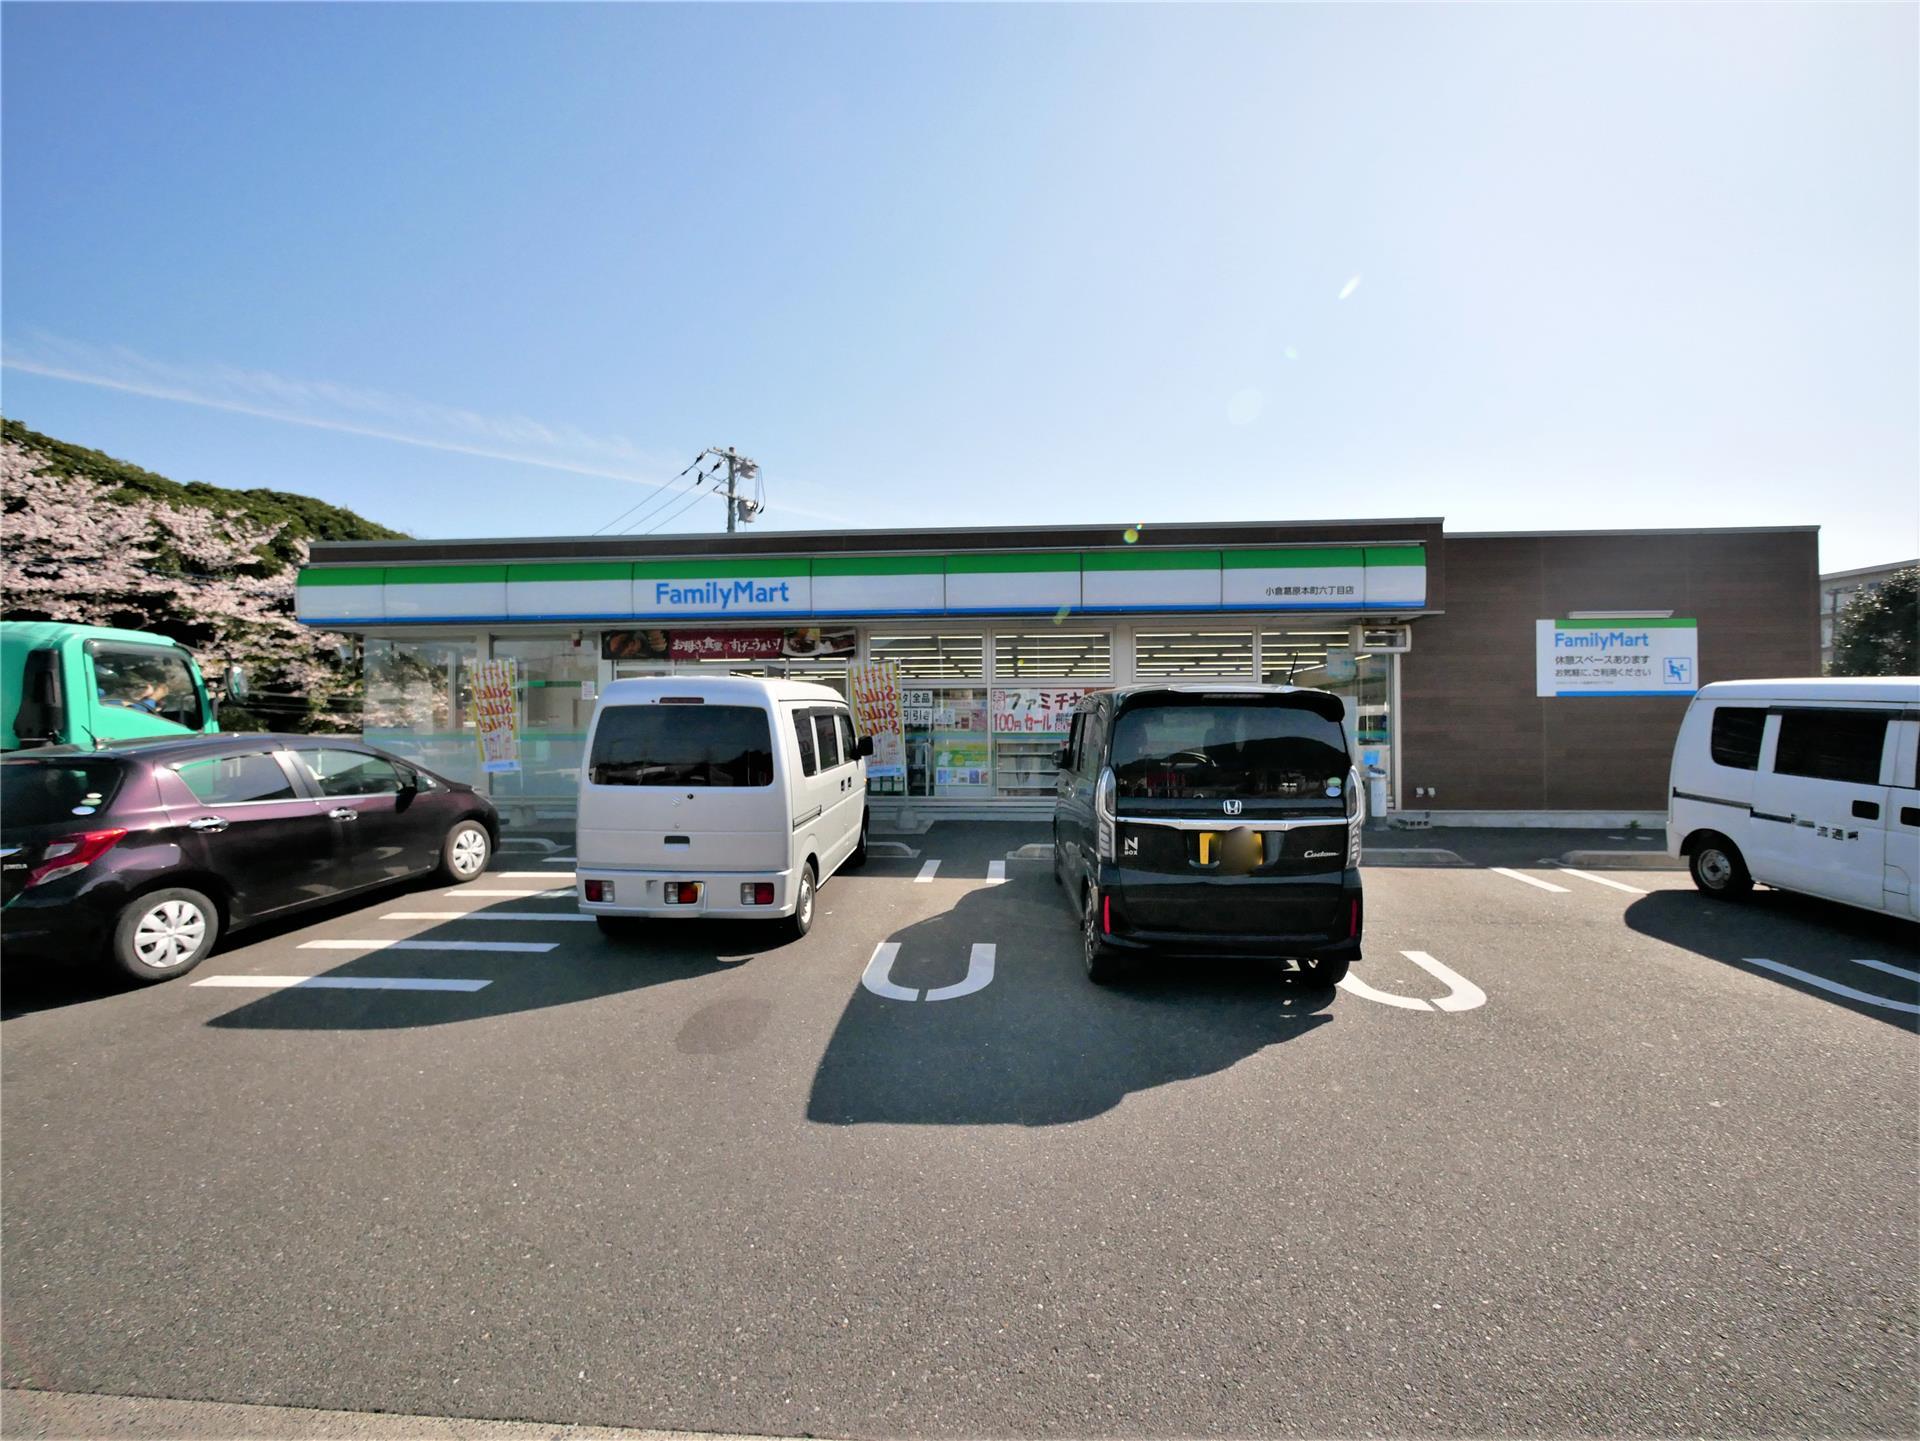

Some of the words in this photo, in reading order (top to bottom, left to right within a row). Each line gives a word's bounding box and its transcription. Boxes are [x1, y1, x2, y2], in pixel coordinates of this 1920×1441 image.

[656, 580, 789, 609] FamilyMart
[1555, 632, 1649, 650] FamilyMart
[1555, 655, 1650, 665] 休憩スペースあります
